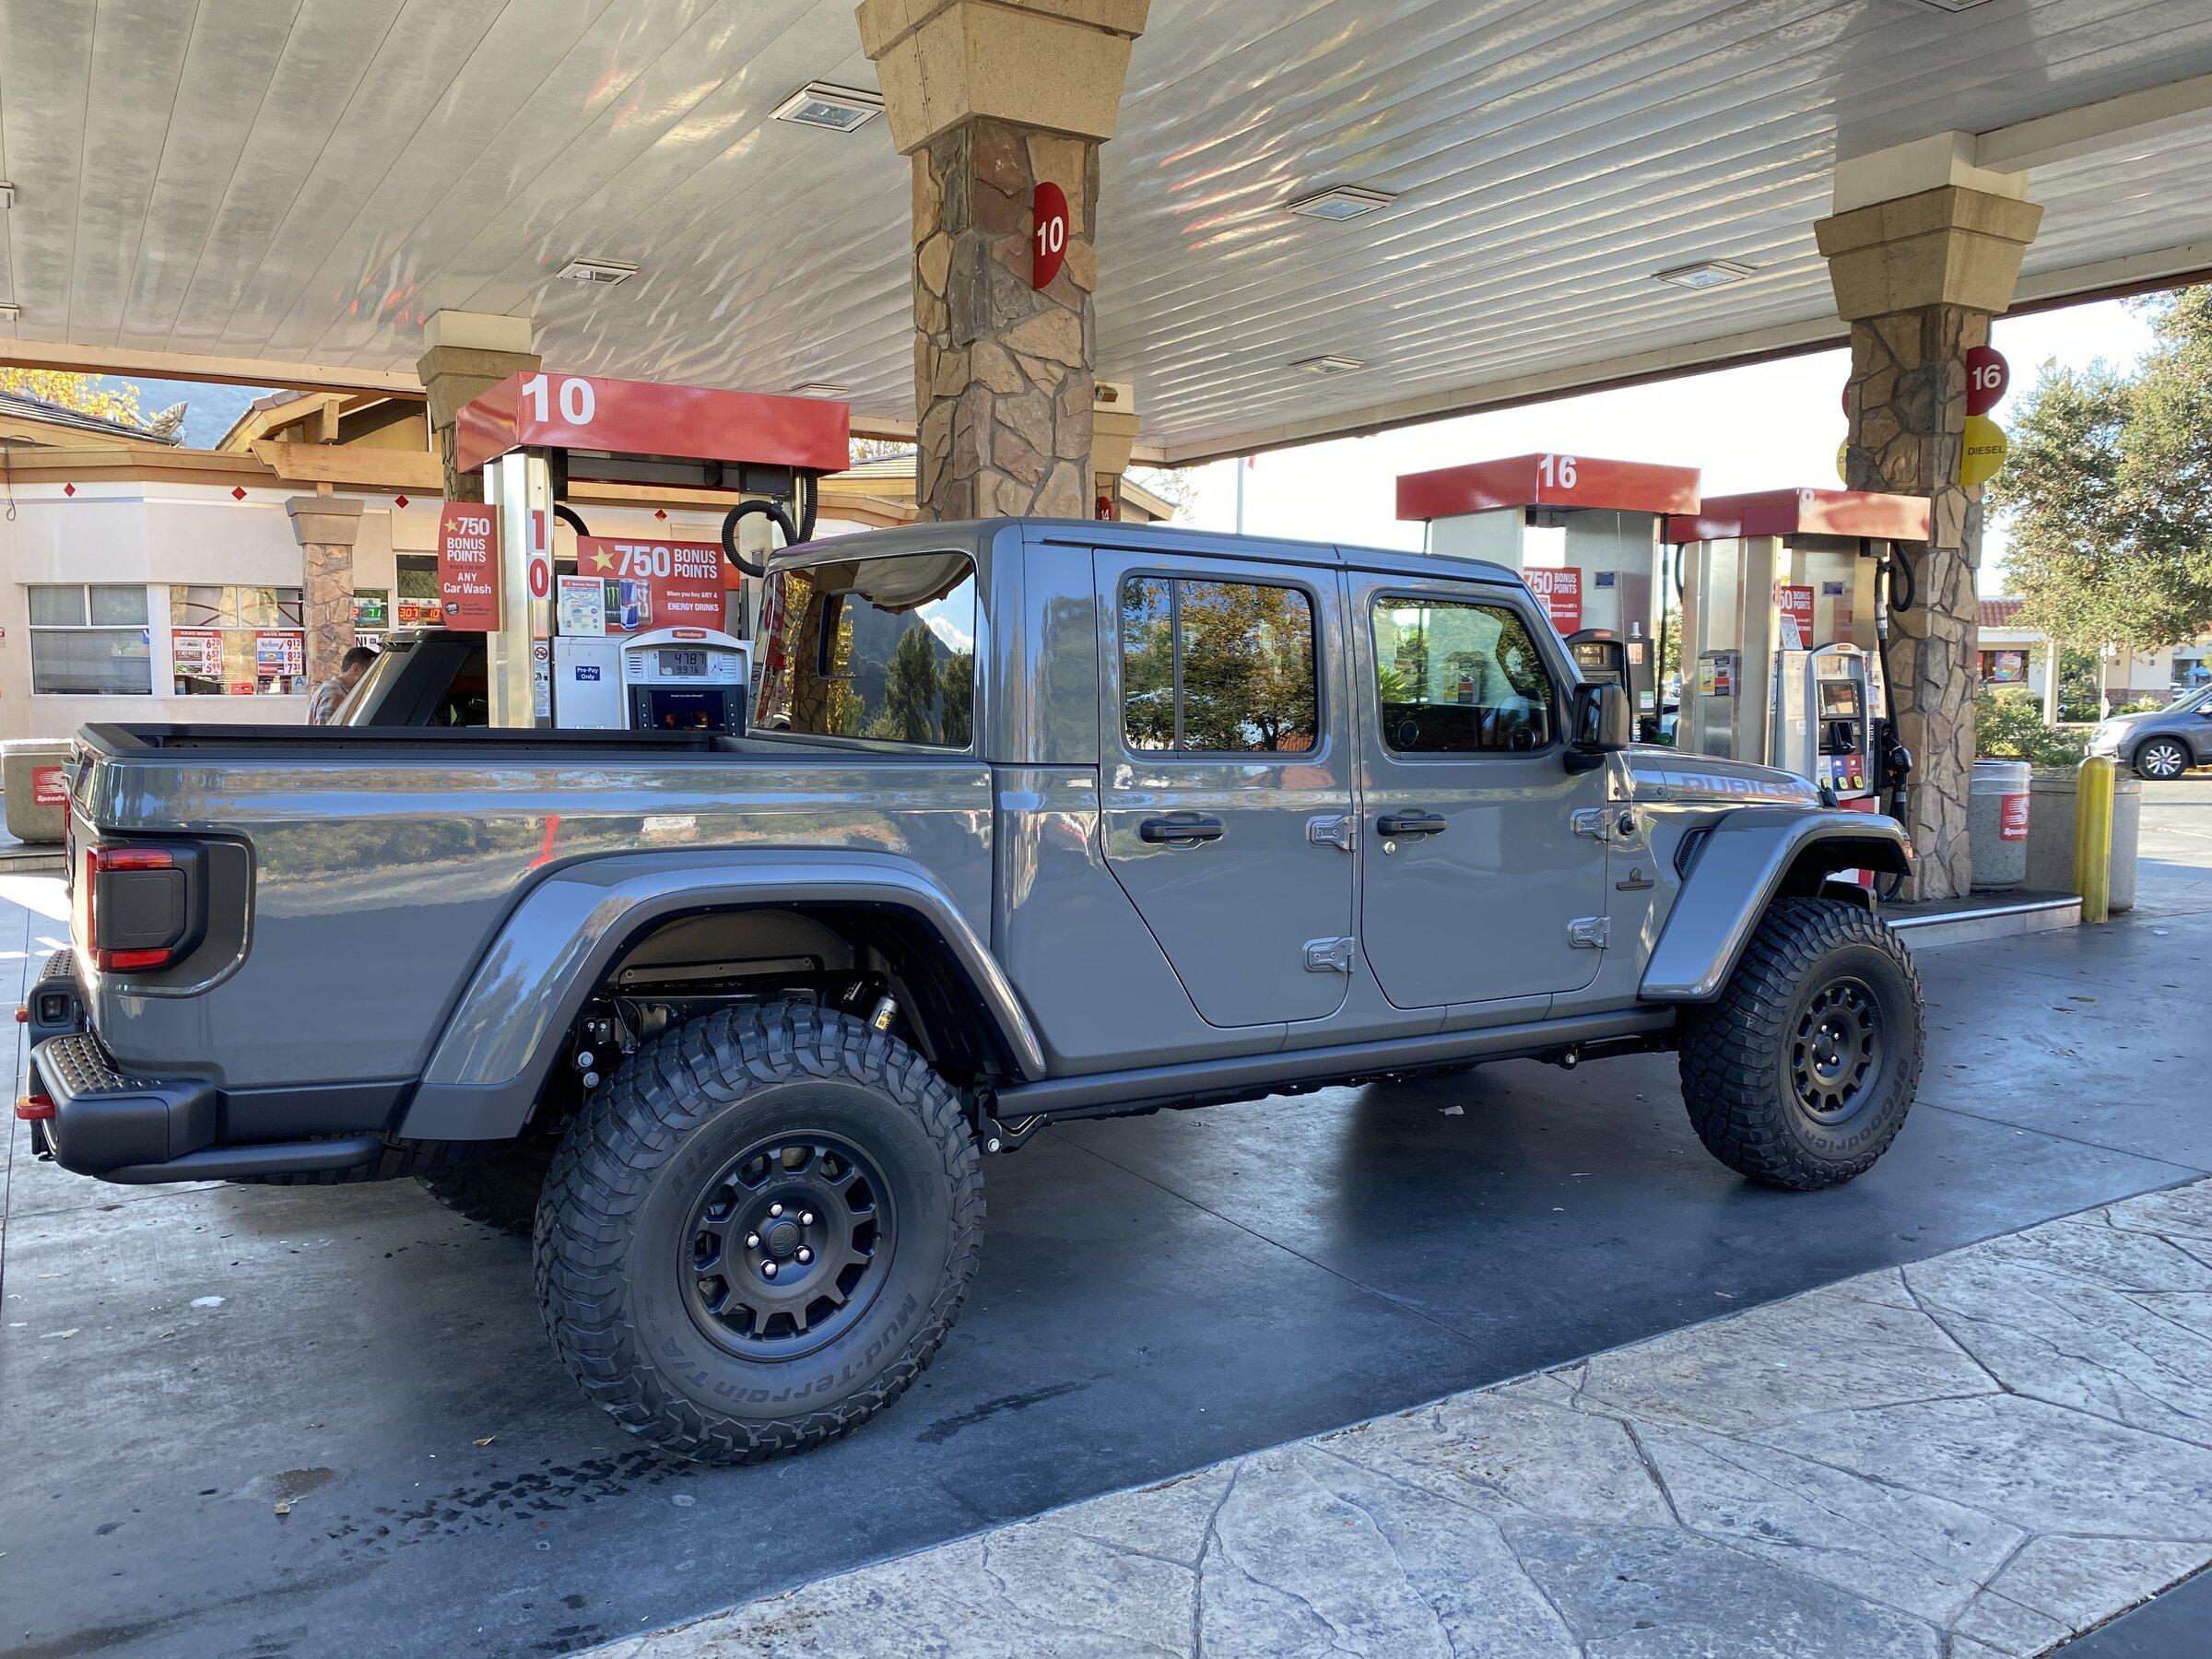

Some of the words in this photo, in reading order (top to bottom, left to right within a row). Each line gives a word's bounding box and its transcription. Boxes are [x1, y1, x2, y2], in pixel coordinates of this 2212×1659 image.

[1037, 216, 1064, 256] 10
[1971, 364, 2002, 391] 16
[522, 373, 595, 425] 10
[1967, 445, 2005, 455] DIESEL
[1540, 453, 1577, 488] 16
[457, 517, 490, 535] 750
[447, 537, 486, 550] BONUS
[447, 549, 487, 562] POINTS
[615, 545, 670, 578] 750
[675, 548, 716, 564] BONUS
[458, 573, 477, 582] ANY
[675, 563, 717, 579] POINTS
[1554, 572, 1577, 583] BONUS
[444, 582, 461, 594] Car
[464, 583, 491, 594] Wash
[1524, 571, 1553, 594] 750
[1554, 583, 1577, 594] POINTS
[667, 602, 694, 611] ENERGY
[695, 603, 719, 612] DRINKS
[36, 794, 65, 803] Speed
